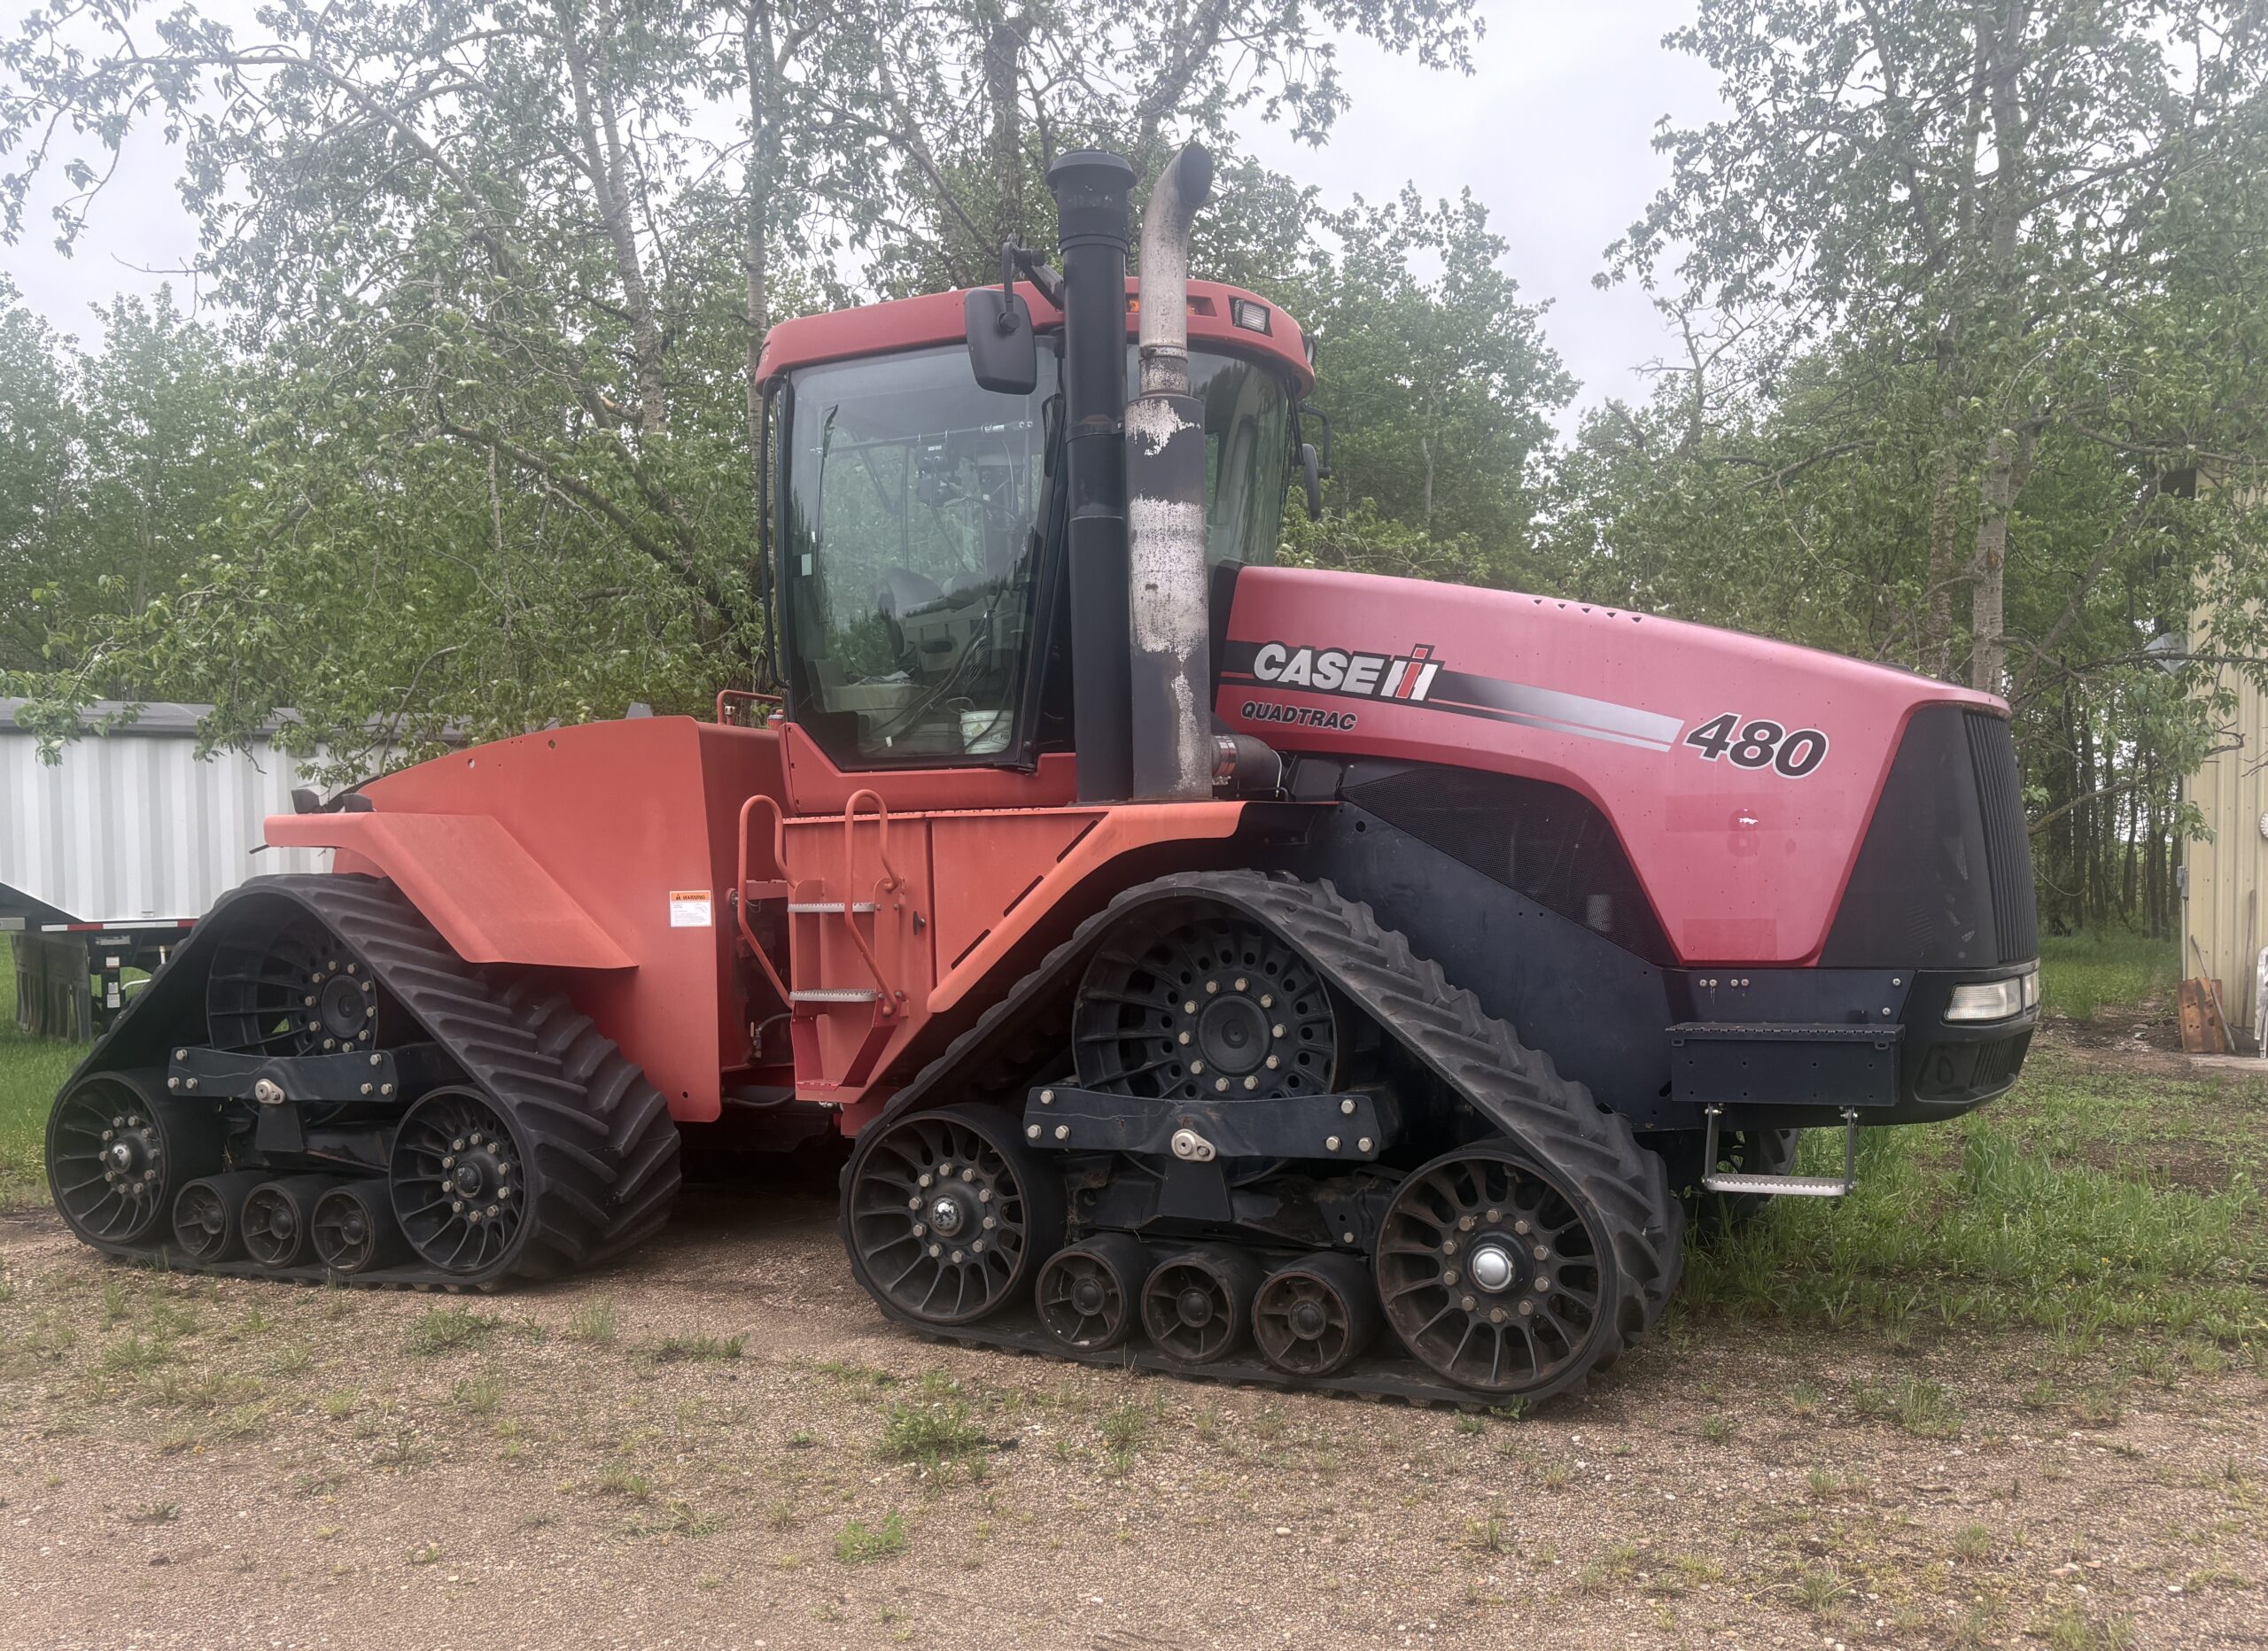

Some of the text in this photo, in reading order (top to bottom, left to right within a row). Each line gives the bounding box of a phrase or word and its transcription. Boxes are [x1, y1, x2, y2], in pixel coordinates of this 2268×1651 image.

[1254, 643, 1386, 695] CASE
[1241, 701, 1357, 731] QUADTRAC
[1682, 711, 1829, 779] 480
